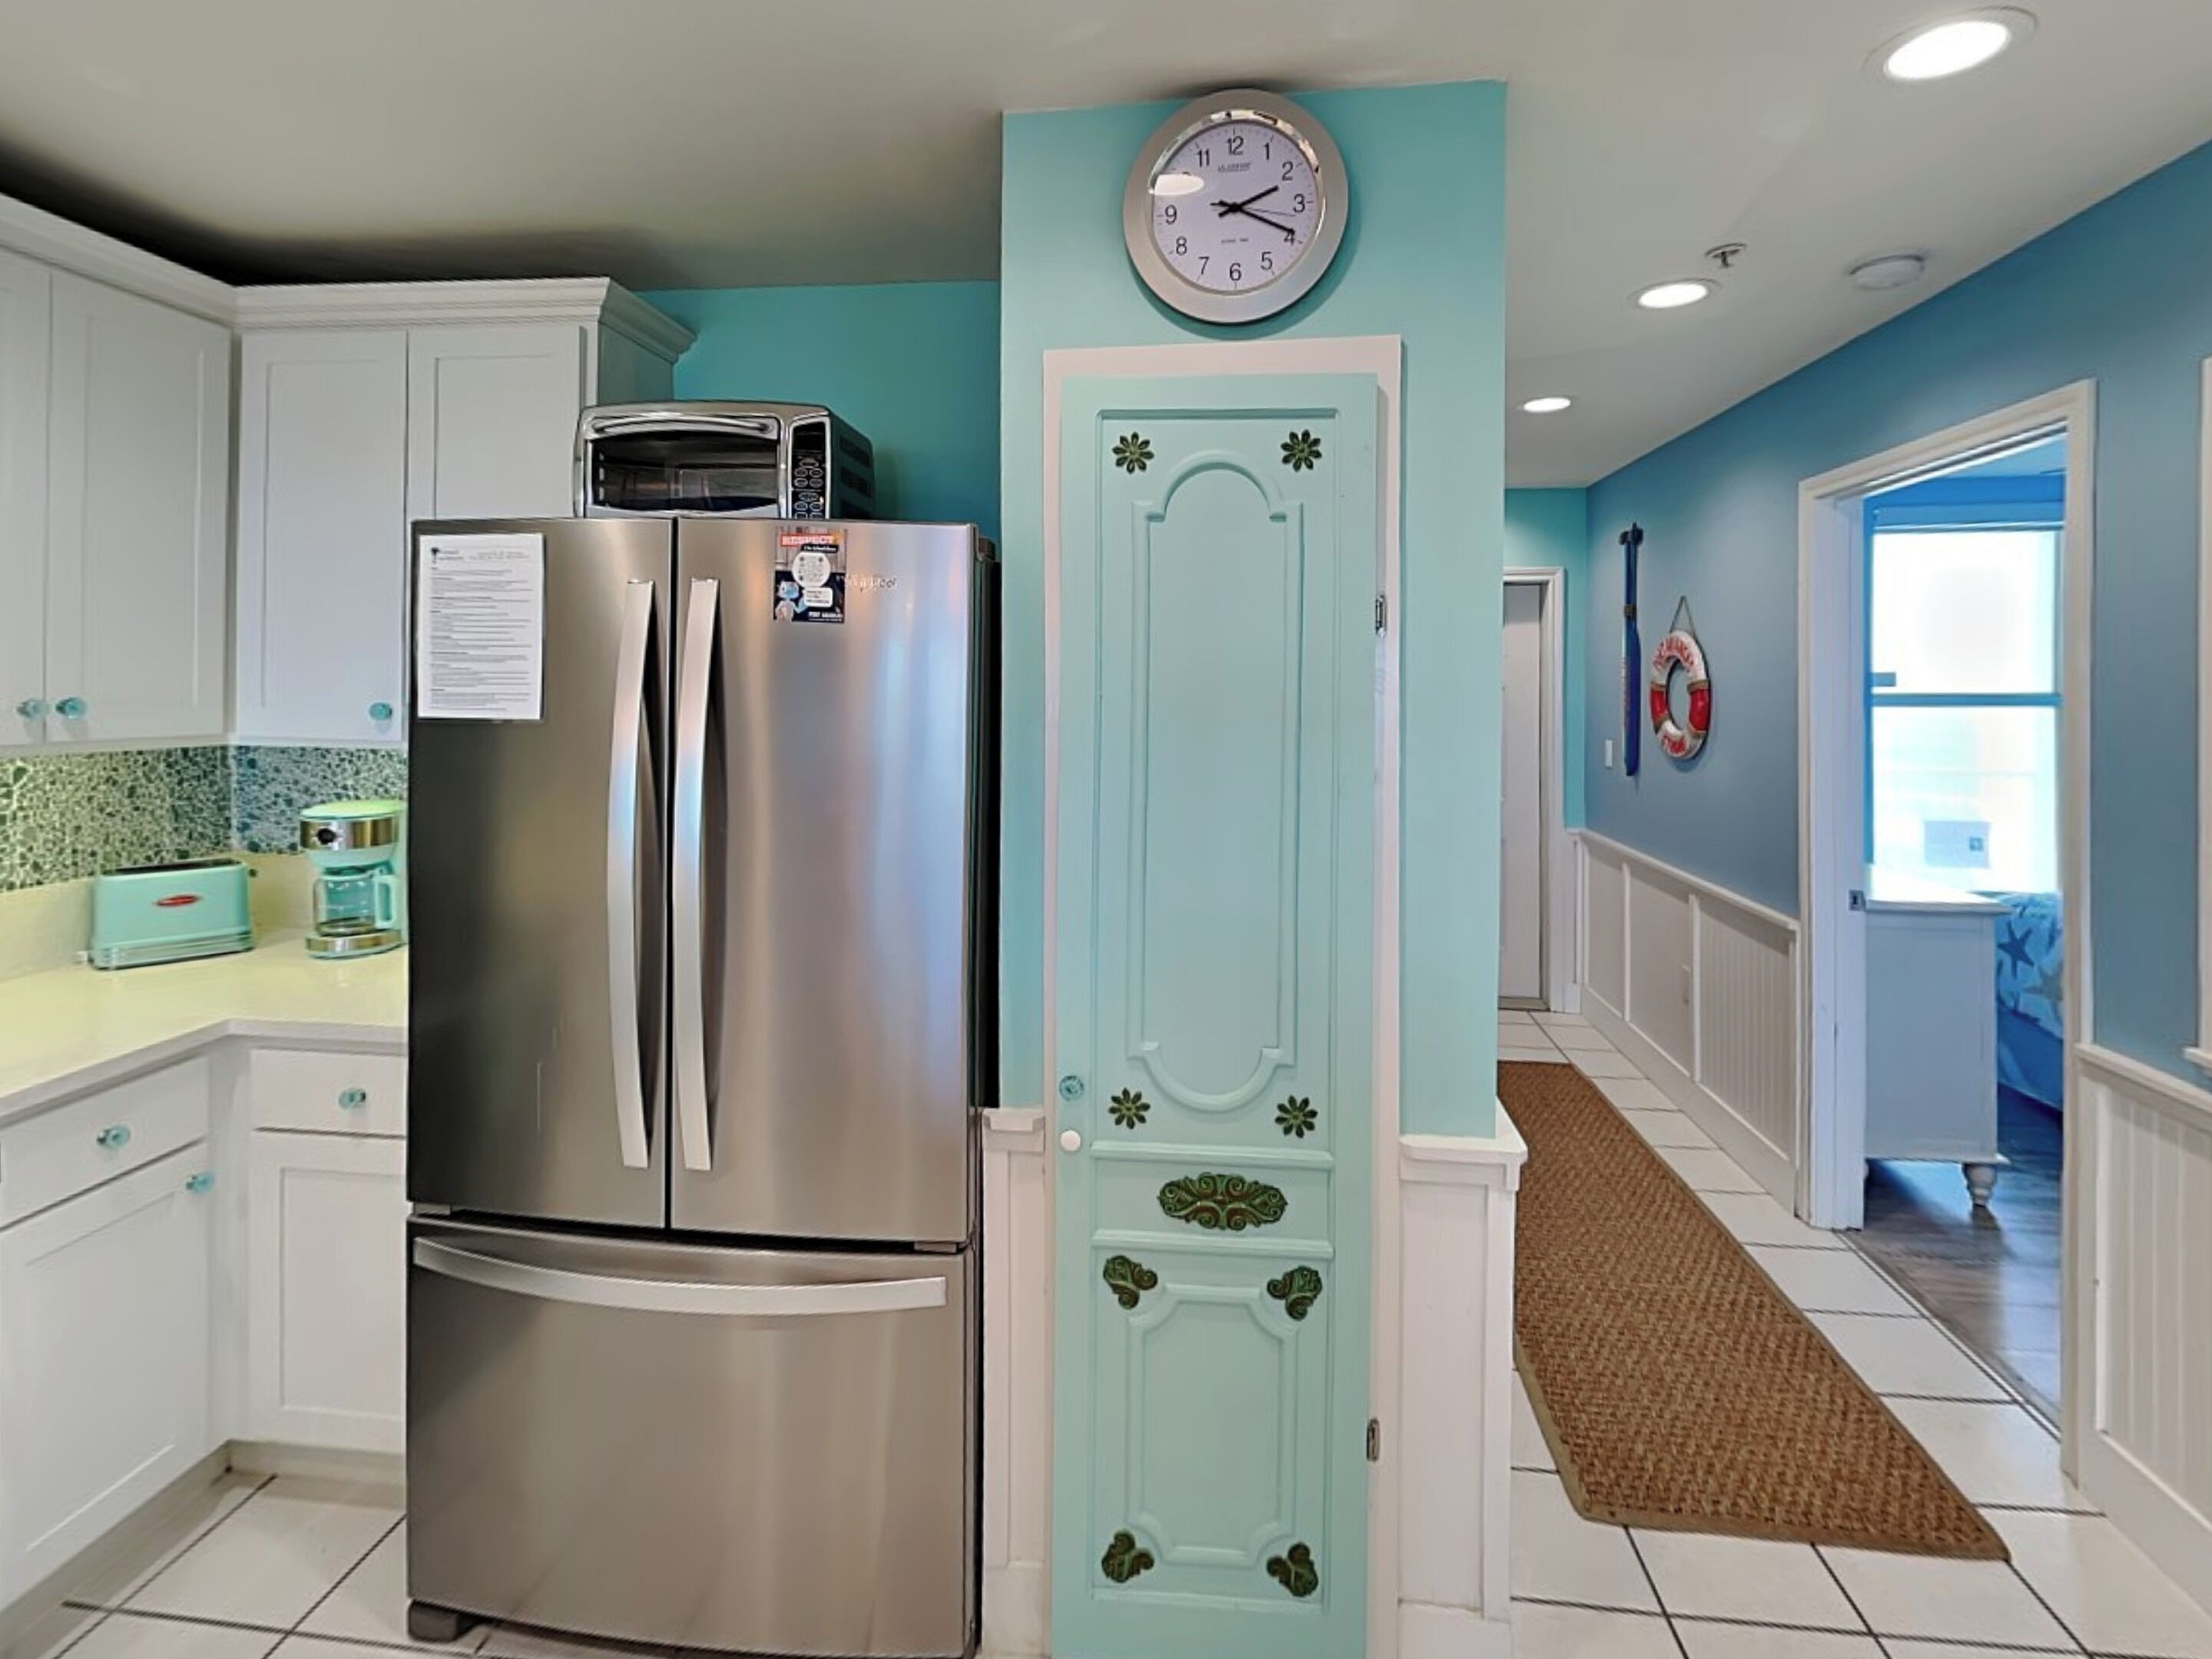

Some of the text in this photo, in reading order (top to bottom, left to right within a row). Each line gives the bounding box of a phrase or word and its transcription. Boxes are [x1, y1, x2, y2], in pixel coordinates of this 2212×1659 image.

[1227, 136, 1244, 155] 12
[1263, 142, 1270, 161] 1
[1196, 148, 1210, 167] 11
[1282, 161, 1293, 180] 2
[1293, 194, 1305, 214] 3
[1165, 205, 1177, 224] 9
[1176, 237, 1187, 255] 8
[1283, 229, 1295, 247] 4
[1199, 257, 1210, 274] 7
[1260, 252, 1273, 270] 5
[1230, 263, 1241, 281] 6
